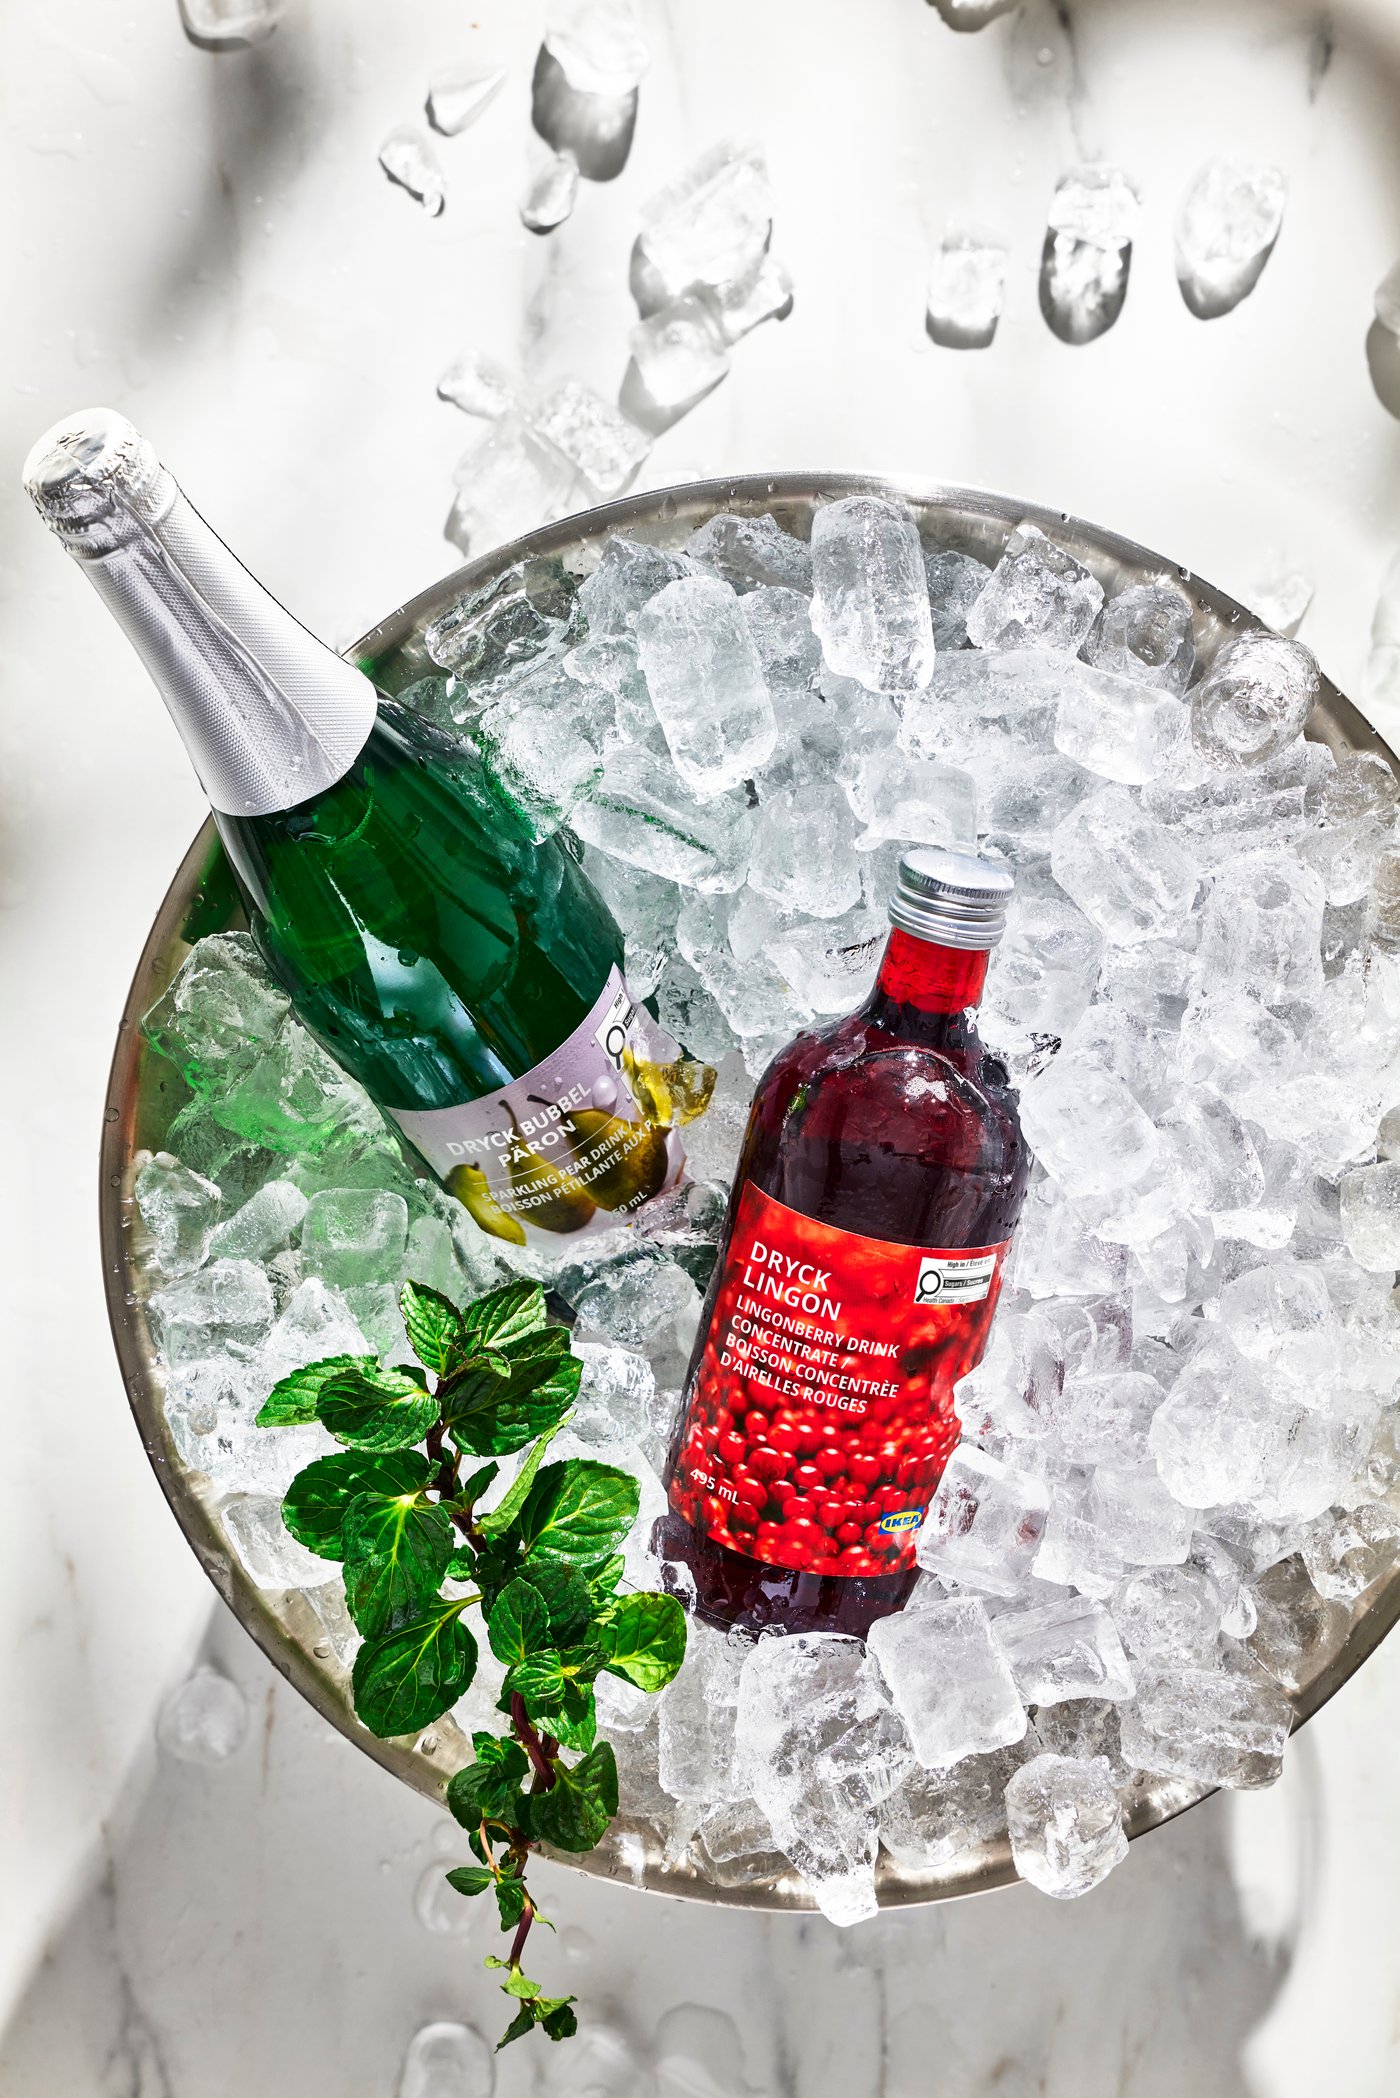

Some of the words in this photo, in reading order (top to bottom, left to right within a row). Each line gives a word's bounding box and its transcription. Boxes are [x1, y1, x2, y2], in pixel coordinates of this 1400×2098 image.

[613, 993, 624, 1009] High
[446, 1127, 520, 1156] DRYCK
[520, 1083, 591, 1136] BUBBEL
[498, 1119, 577, 1168] PÄRON
[481, 1174, 558, 1202] SPARKLING
[558, 1156, 592, 1180] PEAR
[590, 1125, 628, 1161] DRINK
[490, 1192, 553, 1215] BOISSON
[553, 1150, 623, 1199] PÉTILLANTE
[622, 1128, 646, 1155] AUX
[629, 1191, 648, 1208] mL
[750, 1240, 832, 1292] DRYCK
[944, 1280, 963, 1288] Sugars
[966, 1278, 984, 1286] Sucres
[947, 1261, 959, 1269] High
[743, 1265, 841, 1321] LINGON
[731, 1314, 839, 1368] CONCENTRATE
[841, 1357, 851, 1369] /
[736, 1295, 845, 1348] LINGONBERRY
[847, 1337, 900, 1358] DRINK
[725, 1332, 792, 1373] BOISSON
[720, 1351, 801, 1397] D'AIRELLES
[802, 1387, 868, 1414] ROUGES
[690, 1468, 716, 1490] 495
[718, 1485, 739, 1506] mL
[884, 1514, 920, 1528] IKEA
